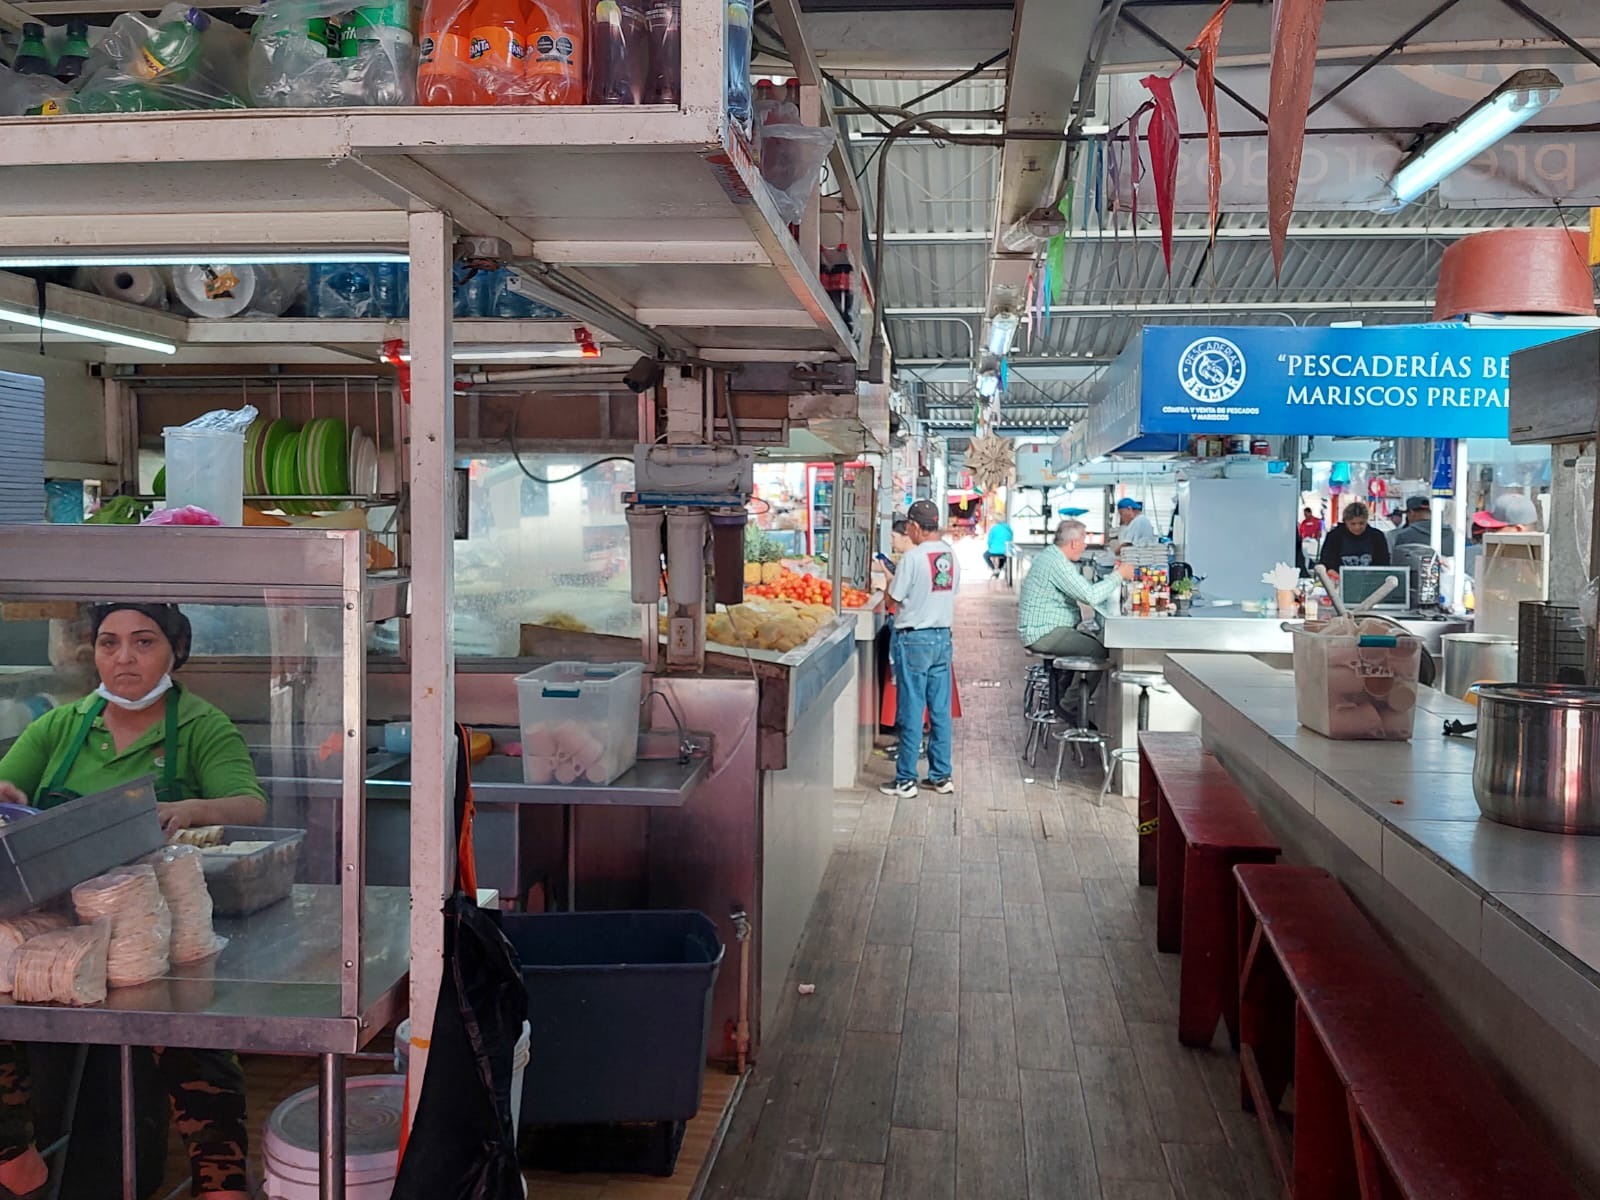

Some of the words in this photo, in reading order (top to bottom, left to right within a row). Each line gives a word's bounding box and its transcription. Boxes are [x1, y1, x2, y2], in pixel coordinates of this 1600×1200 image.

[470, 39, 490, 54] ANTA
[1184, 376, 1241, 401] BELMAR
[1286, 385, 1418, 407] MARISCOS
